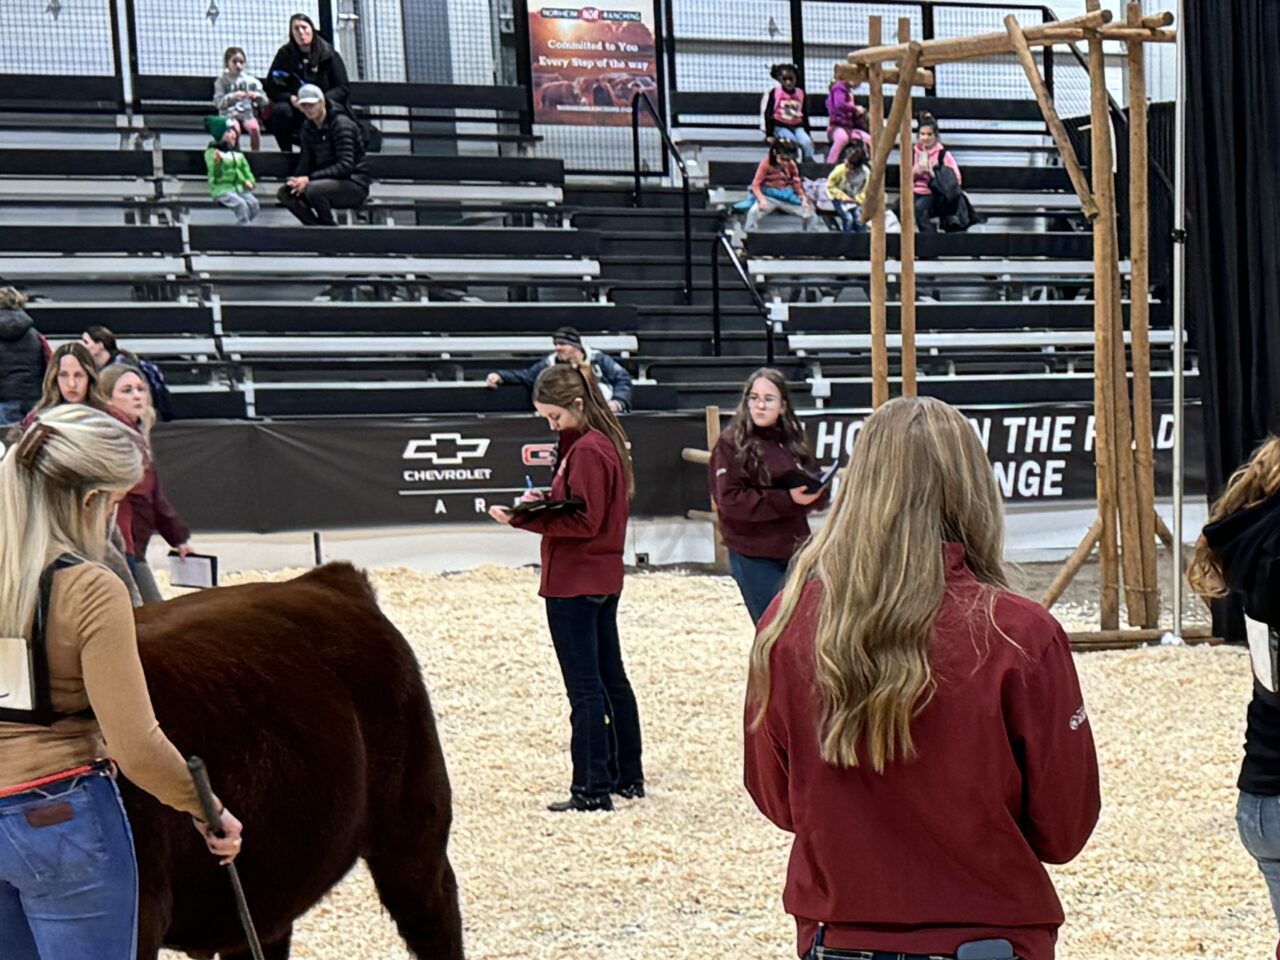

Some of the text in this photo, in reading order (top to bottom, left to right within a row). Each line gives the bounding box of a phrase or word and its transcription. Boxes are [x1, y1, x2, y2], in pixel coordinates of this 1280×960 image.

[547, 40, 639, 52] Committed to You
[538, 56, 649, 71] Every Step of the way
[1003, 416, 1076, 453] THE
[403, 468, 493, 481] CHEVROLET
